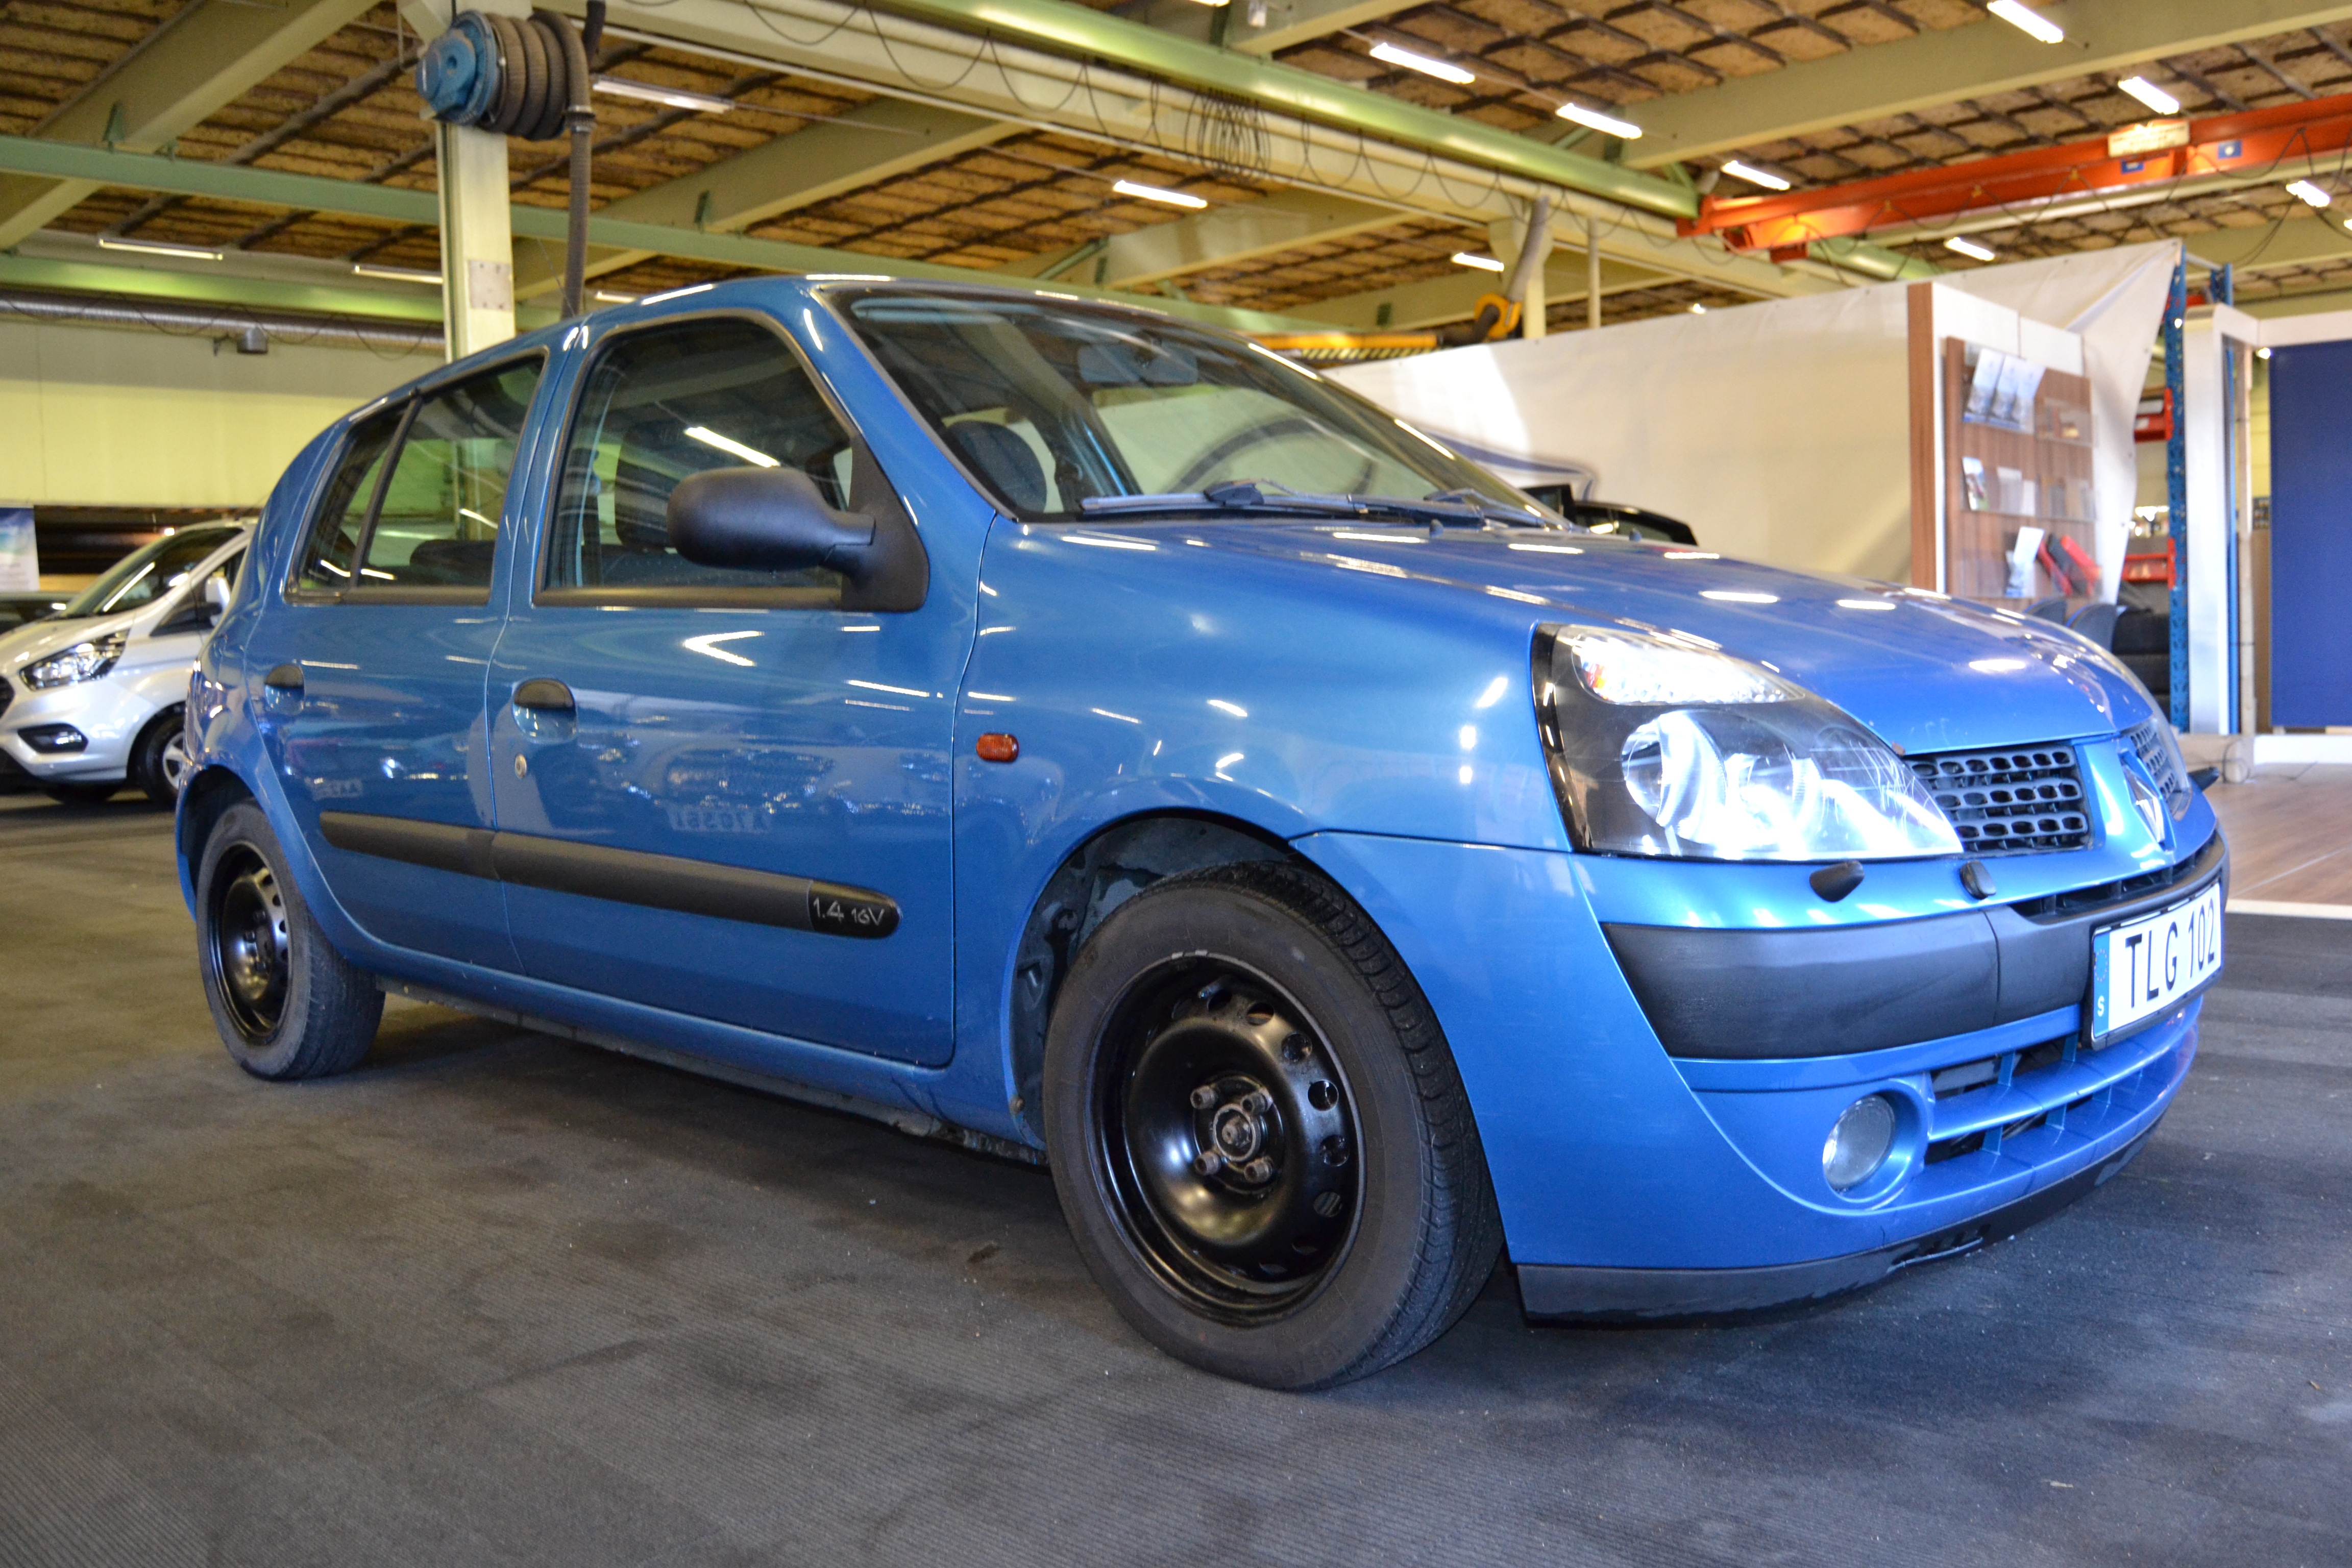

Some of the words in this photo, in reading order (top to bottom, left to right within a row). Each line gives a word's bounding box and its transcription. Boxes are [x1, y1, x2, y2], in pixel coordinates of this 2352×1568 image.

[813, 897, 844, 923] 1.4
[851, 907, 885, 925] 16V
[2125, 921, 2178, 1008] TLG
[2188, 897, 2214, 978] 102
[2097, 995, 2104, 1017] S
